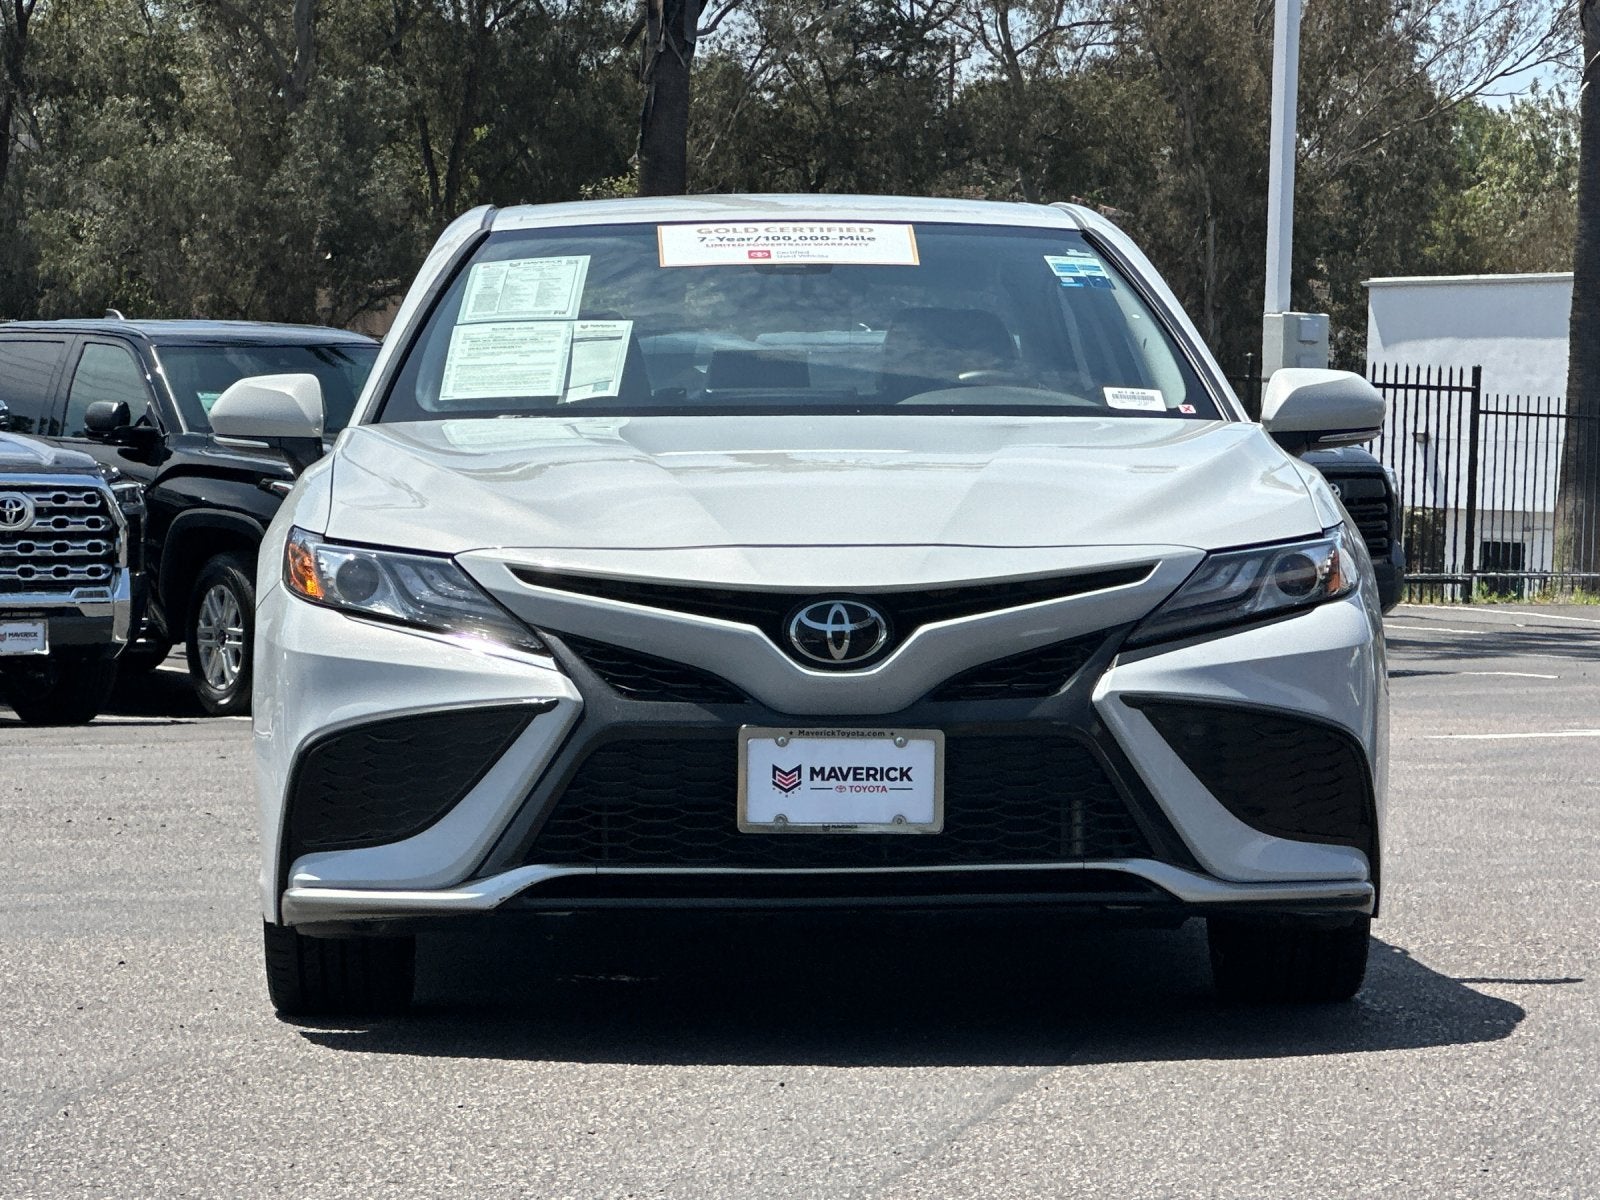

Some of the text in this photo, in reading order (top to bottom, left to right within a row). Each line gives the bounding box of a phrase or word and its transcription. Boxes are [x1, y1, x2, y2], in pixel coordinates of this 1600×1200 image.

[798, 730, 885, 738] MaverickToyota.com
[809, 766, 913, 782] MAVERICK
[849, 785, 888, 793] TOYOTA
